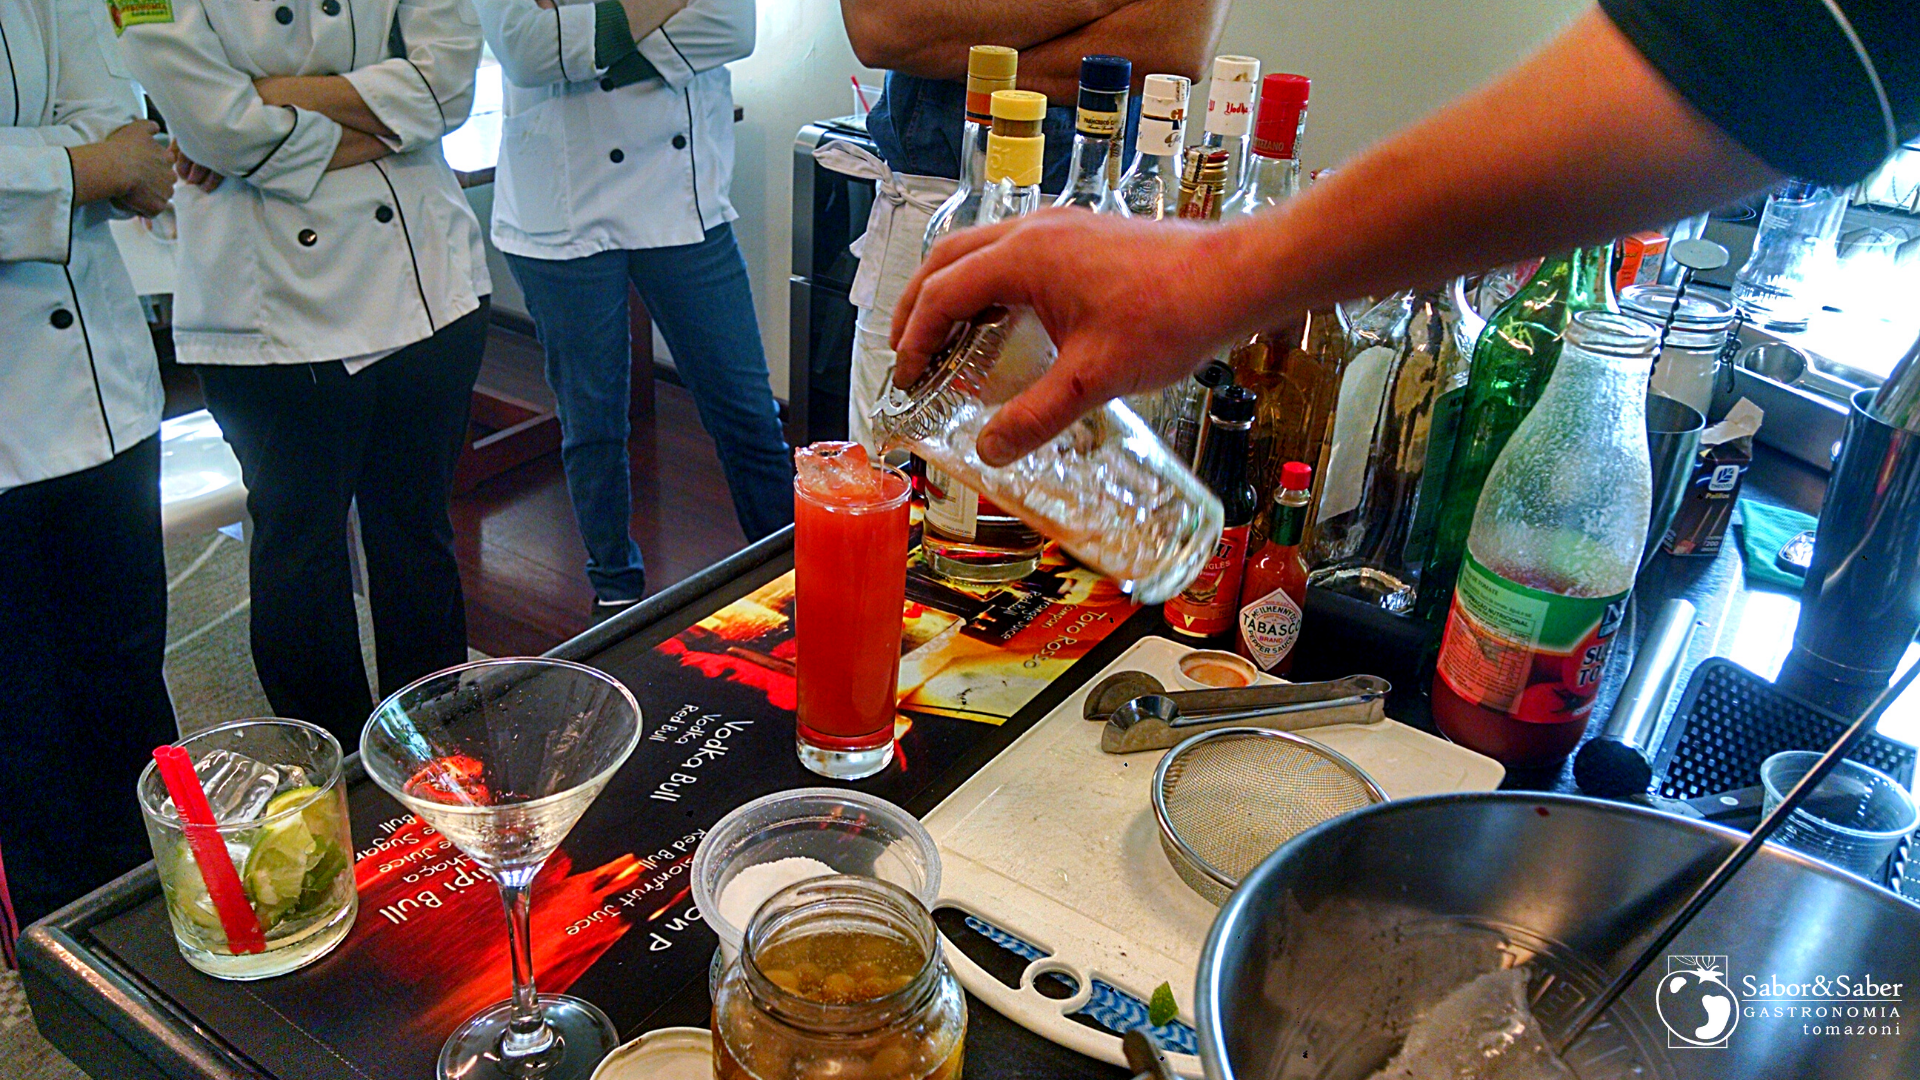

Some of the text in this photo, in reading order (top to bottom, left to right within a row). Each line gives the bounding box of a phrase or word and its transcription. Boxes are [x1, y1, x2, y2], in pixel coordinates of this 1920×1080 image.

[1023, 610, 1108, 669] Toro Rosso
[1259, 635, 1284, 643] BRAND
[648, 703, 700, 742] Red Bull
[674, 713, 722, 745] Vodka
[649, 720, 755, 802] Vodka Bull
[378, 813, 418, 834] Bull
[355, 832, 420, 862] Sugar
[378, 847, 437, 873] Juice
[637, 828, 707, 871] Red Bull
[402, 853, 472, 884] chaça
[378, 866, 493, 925] ipi Bull
[564, 904, 622, 936] Juice
